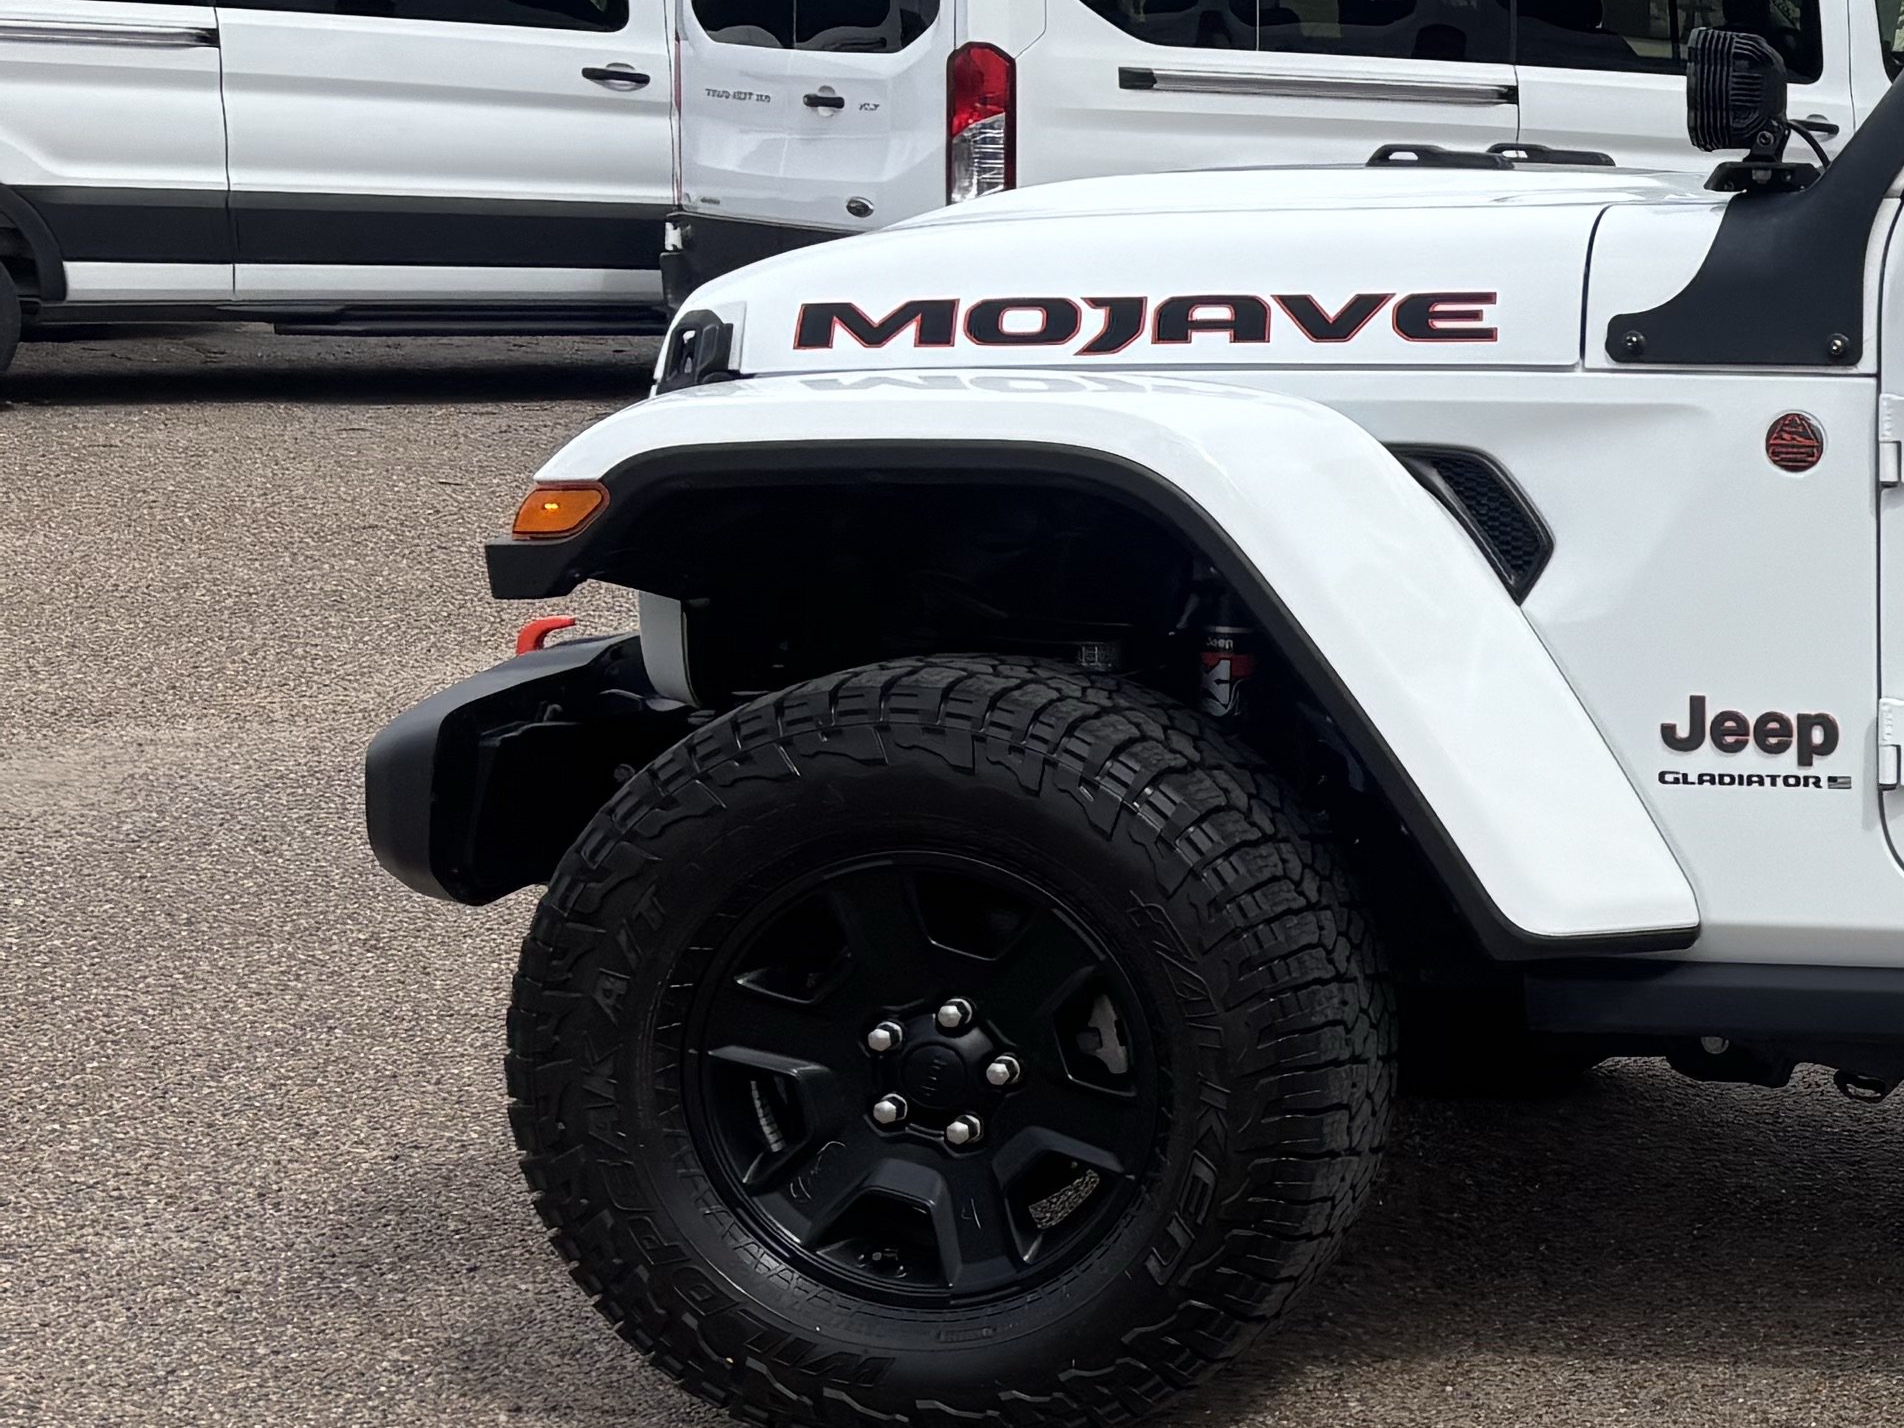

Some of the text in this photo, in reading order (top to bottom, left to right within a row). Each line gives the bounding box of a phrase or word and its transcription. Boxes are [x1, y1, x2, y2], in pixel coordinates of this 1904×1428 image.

[793, 291, 1498, 357] MOJAVE
[1660, 695, 1839, 767] Jeep
[1658, 771, 1823, 789] GLADIATOR
